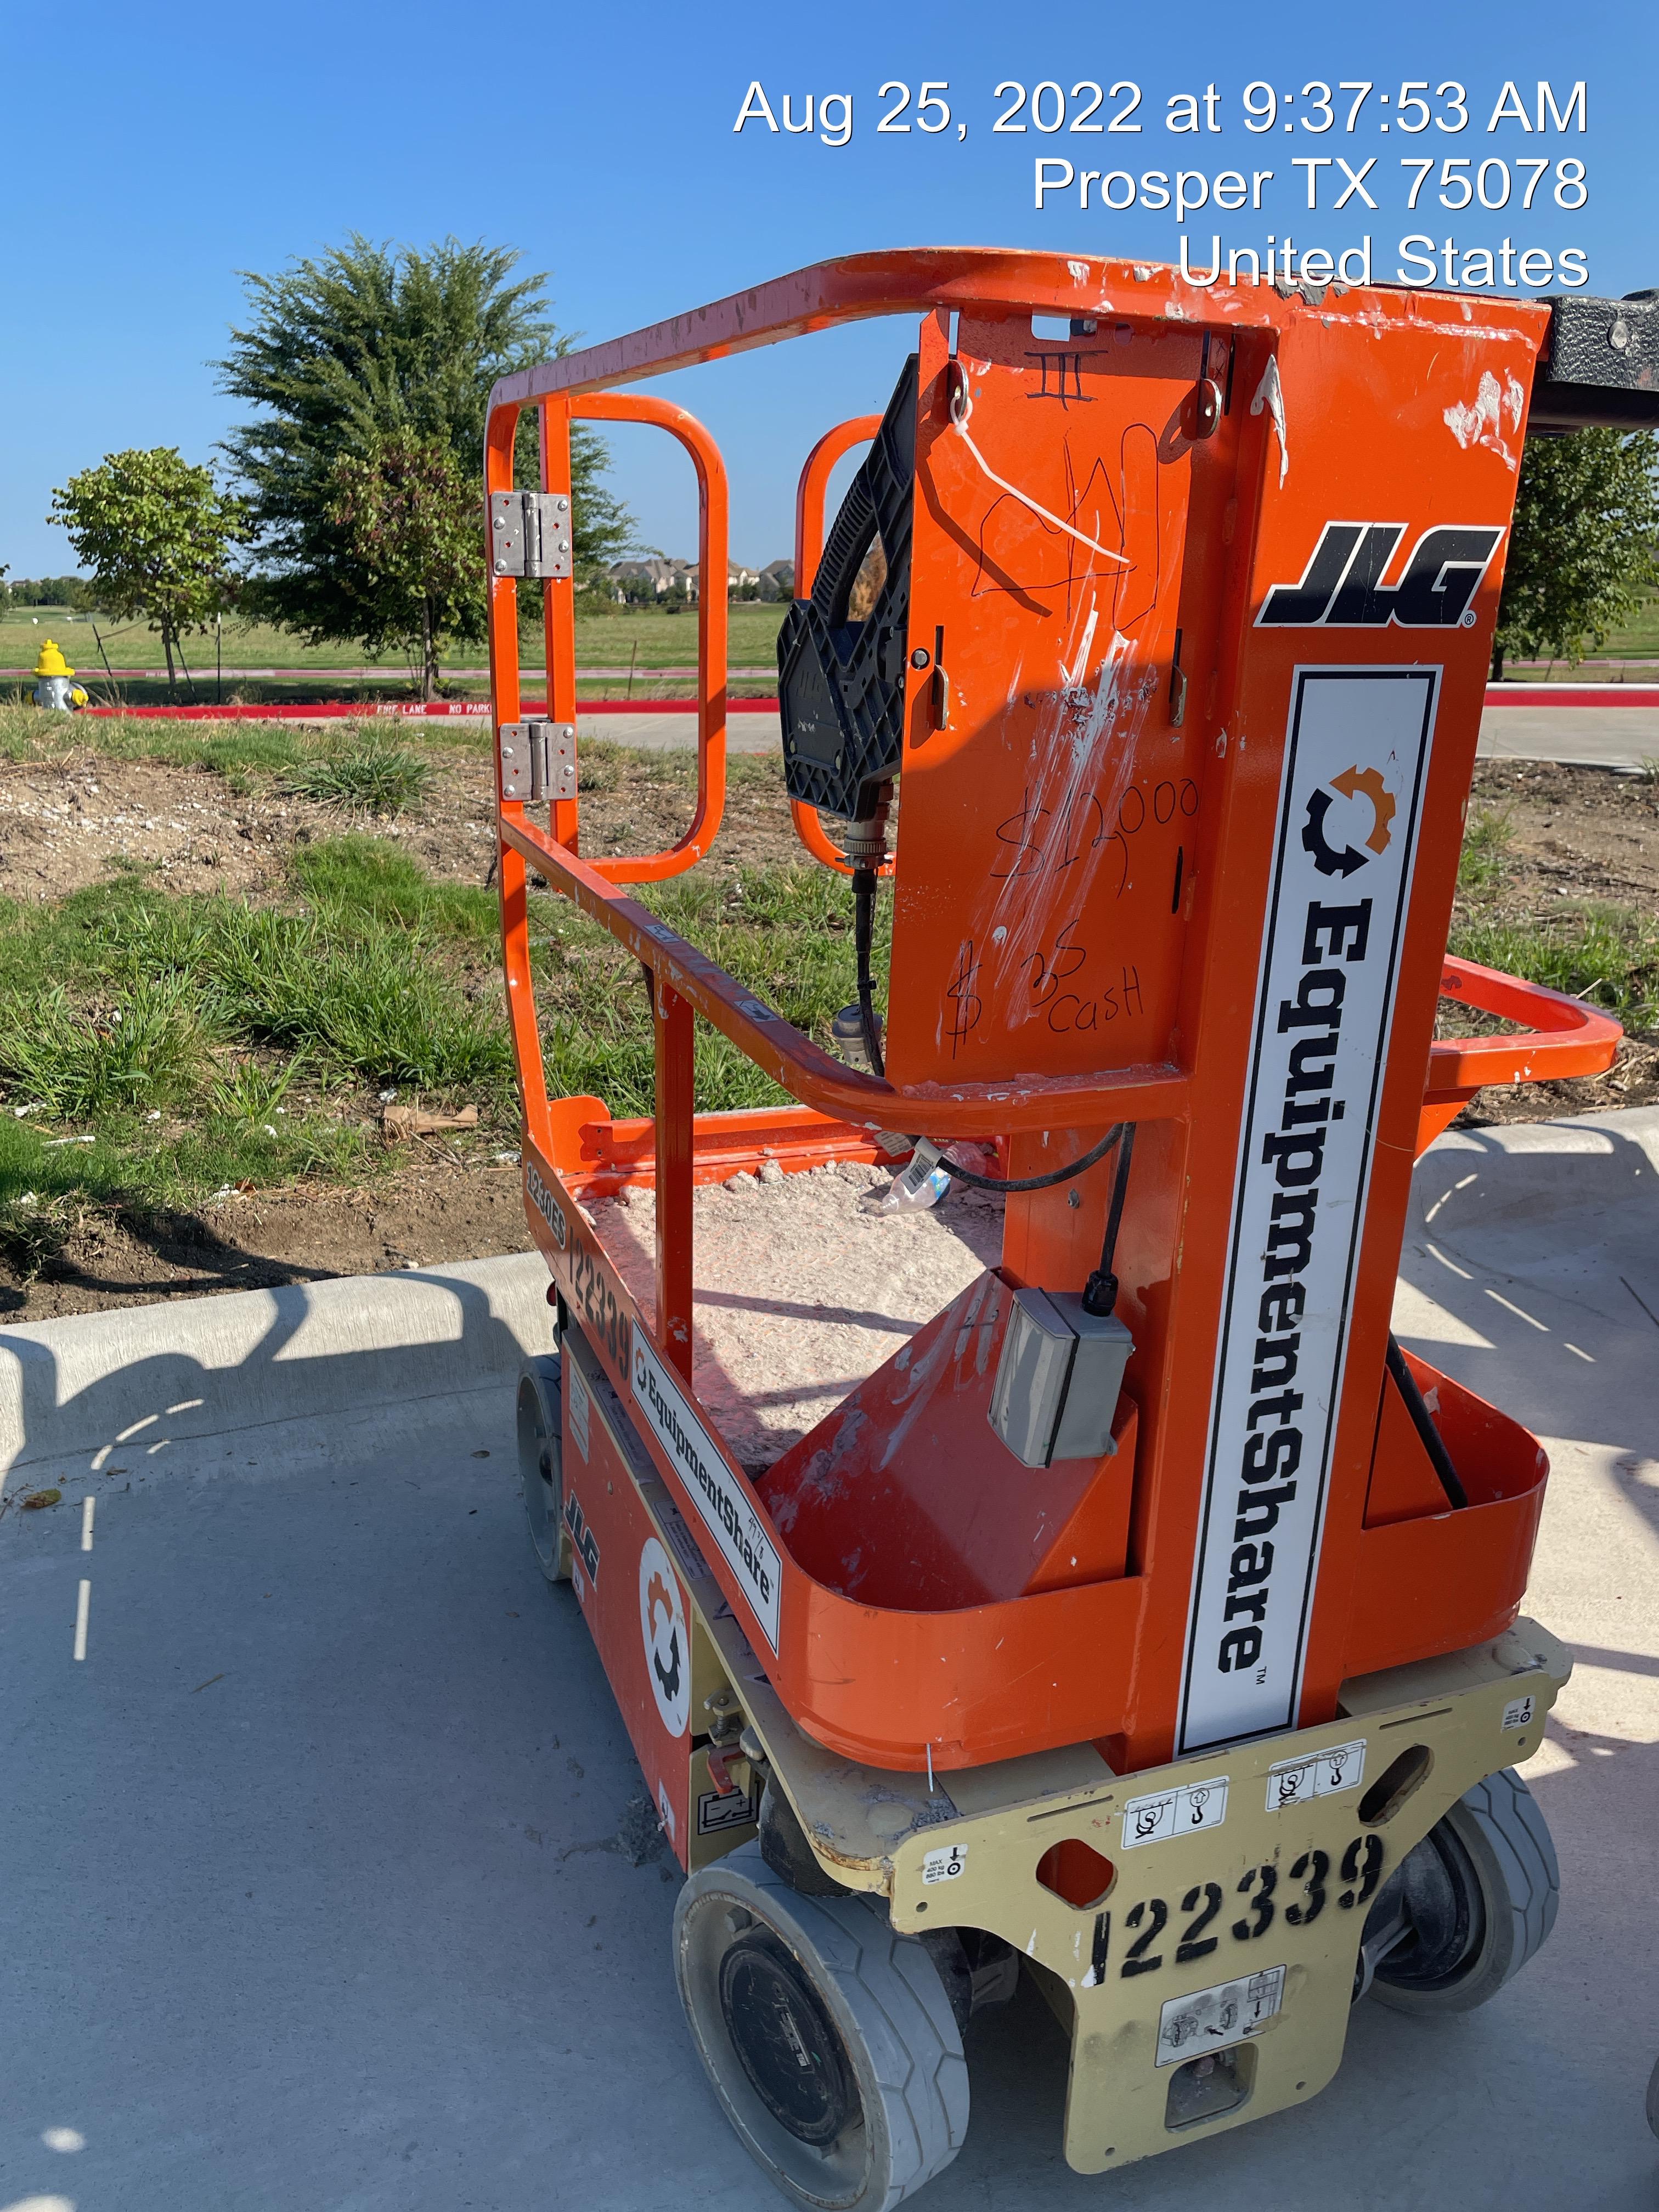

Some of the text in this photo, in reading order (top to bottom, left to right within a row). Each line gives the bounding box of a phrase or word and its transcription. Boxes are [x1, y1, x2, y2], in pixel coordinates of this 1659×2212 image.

[1253, 521, 1507, 628] JLG
[402, 704, 427, 715] LANE
[449, 703, 462, 714] NO
[527, 1161, 566, 1250] 1230ES
[1218, 898, 1373, 1673] EquipmentShare
[563, 1488, 601, 1591] JLG
[648, 1369, 770, 1605] EquipmentShare
[1091, 1834, 1385, 1986] 122339
